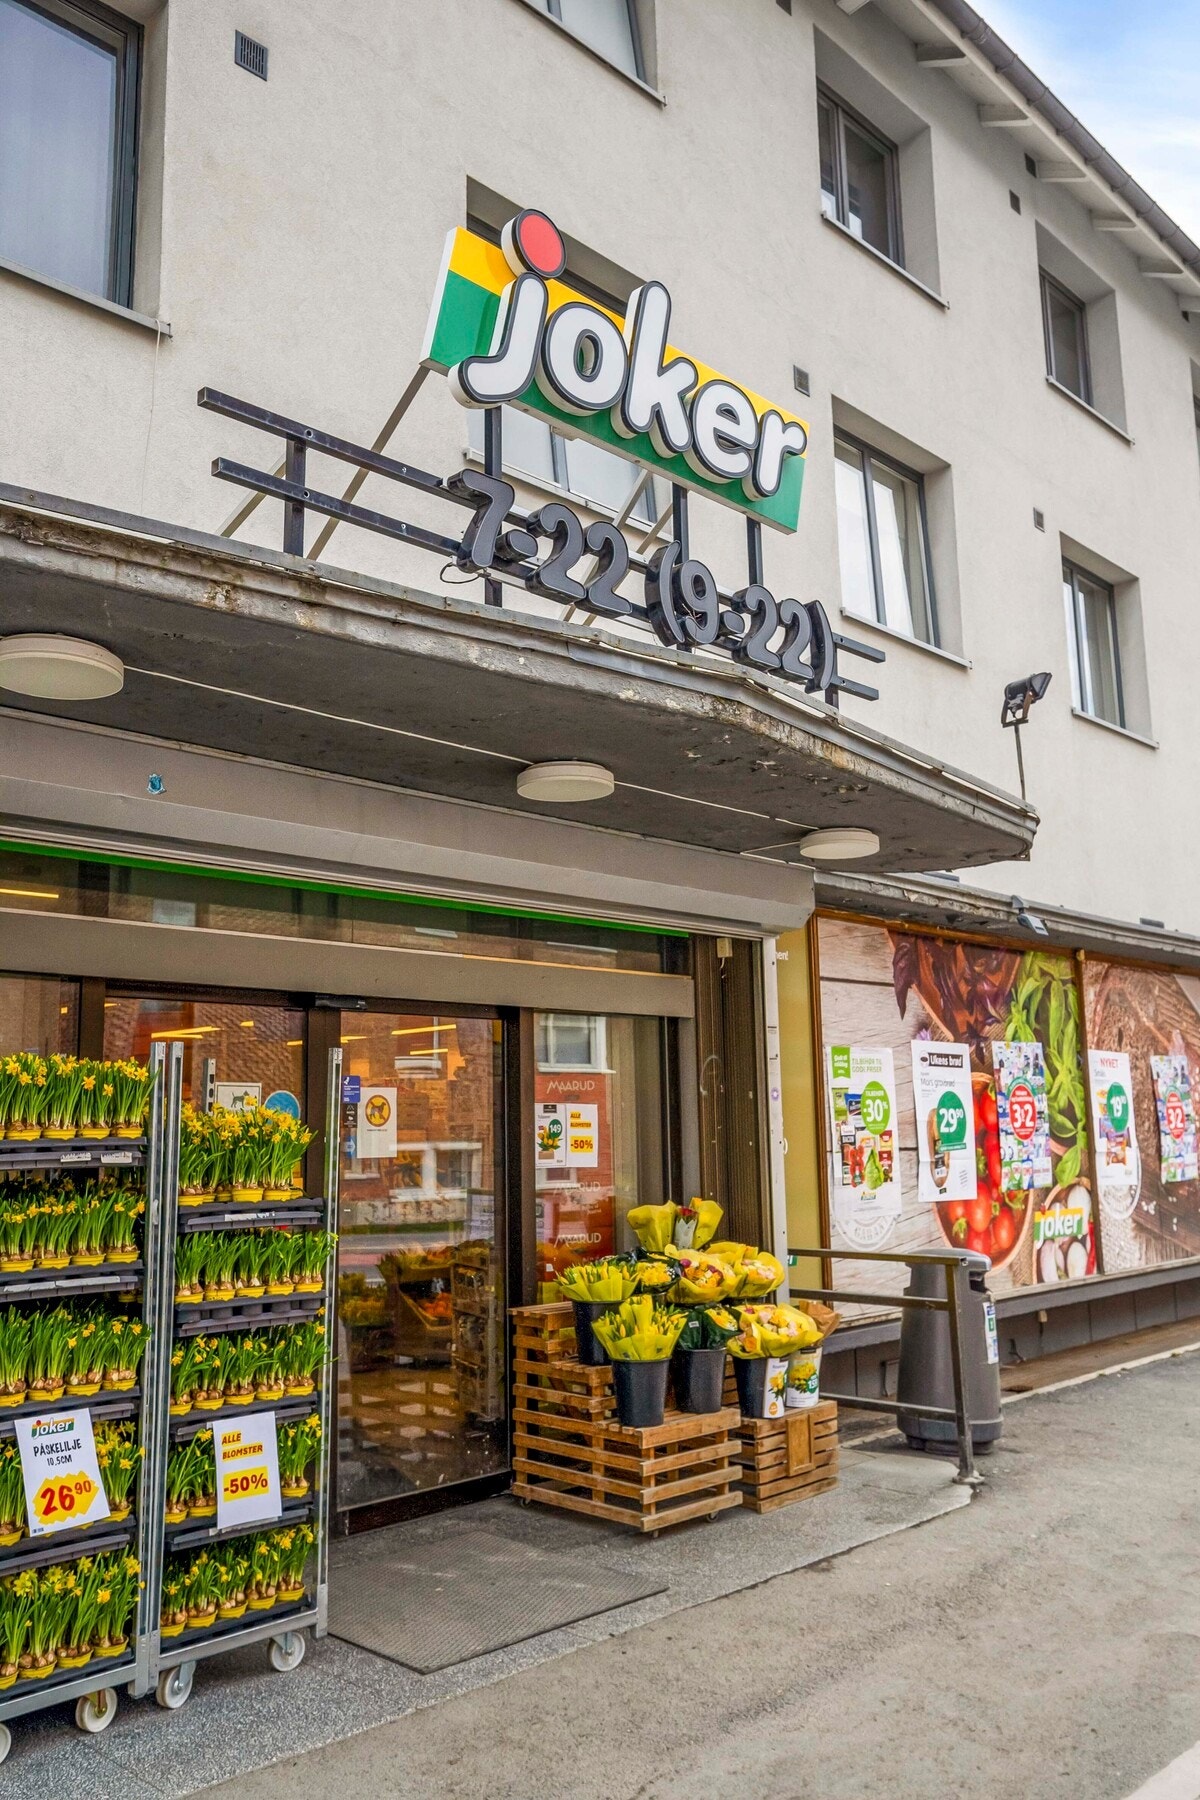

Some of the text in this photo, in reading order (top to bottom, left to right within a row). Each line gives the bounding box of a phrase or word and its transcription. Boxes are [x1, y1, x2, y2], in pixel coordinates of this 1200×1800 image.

[450, 209, 808, 500] joker
[448, 469, 836, 692] 7-22 (9-22)
[930, 1055, 949, 1066] Ukens
[546, 1080, 595, 1094] MAARUD
[550, 1124, 562, 1133] 149
[570, 1139, 593, 1149] -50%
[1036, 1204, 1082, 1249] joker
[33, 1417, 72, 1439] joker
[33, 1438, 82, 1457] PÅSKELILJE
[222, 1433, 242, 1445] ALLE
[222, 1444, 263, 1460] BLOMSTER
[223, 1473, 268, 1494] -50%
